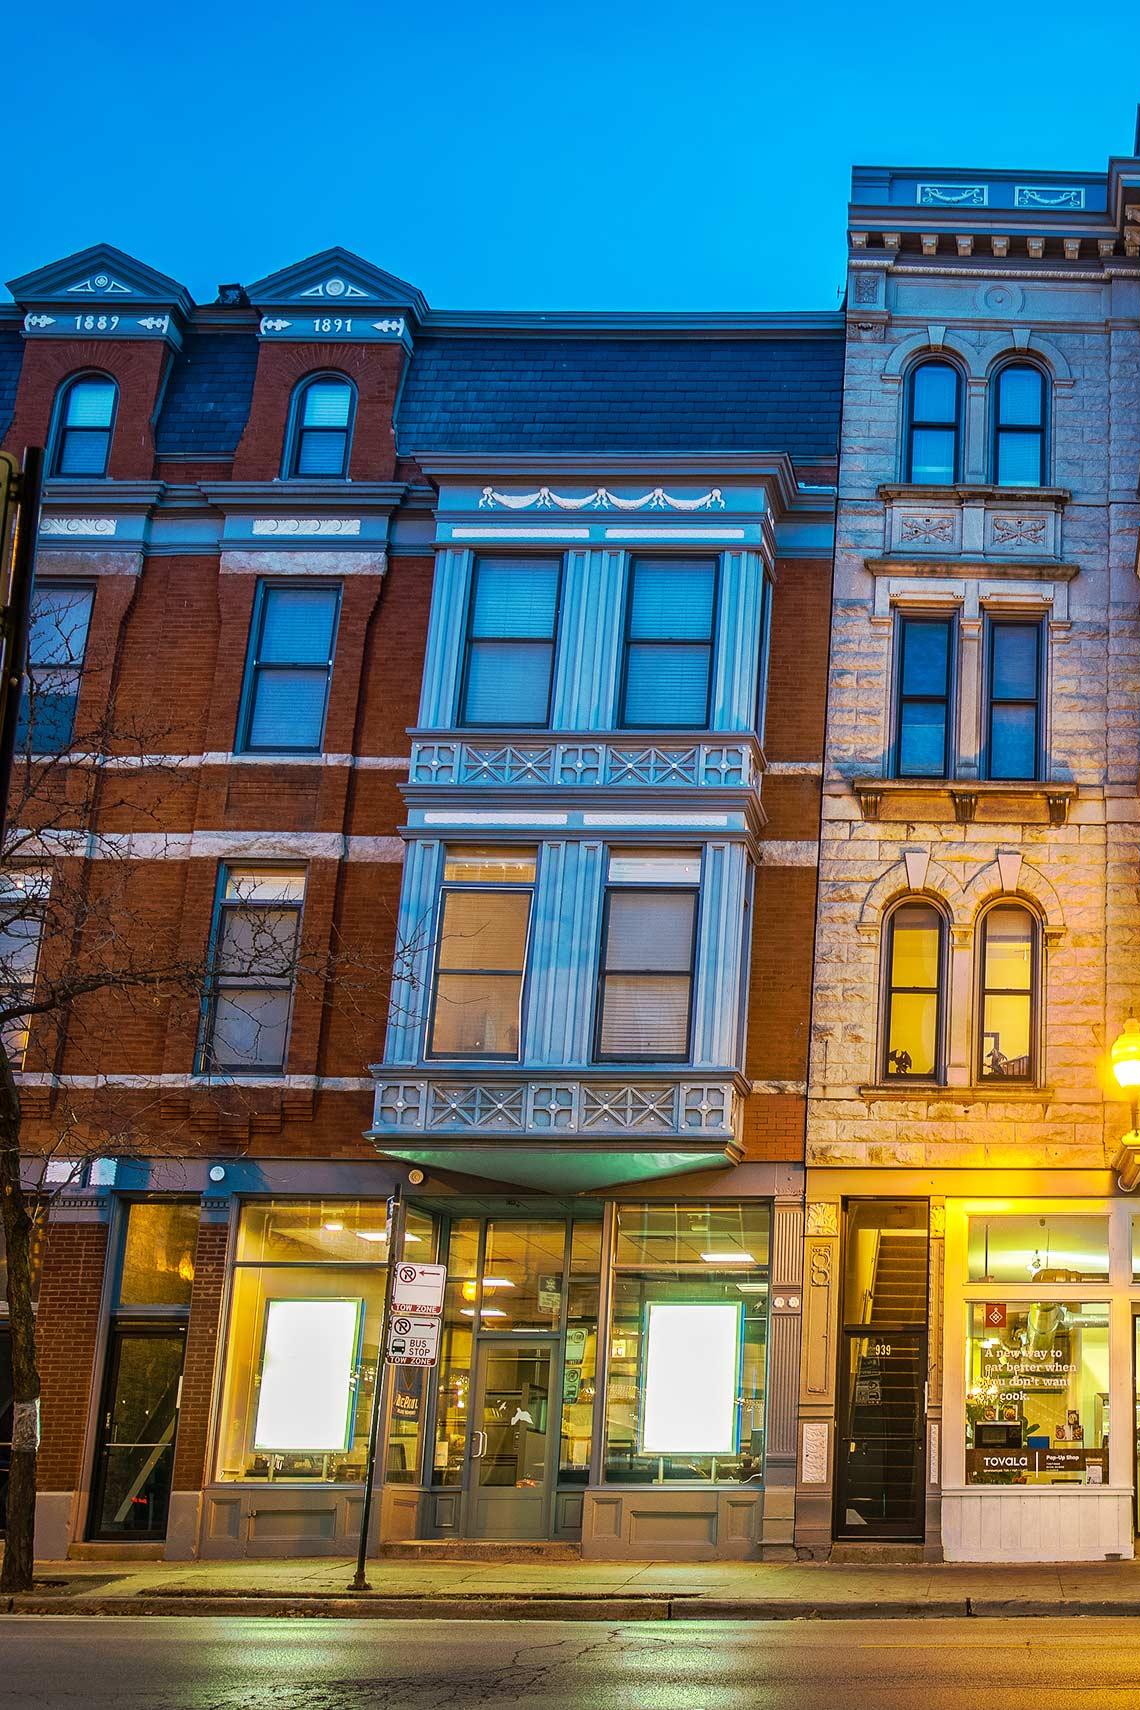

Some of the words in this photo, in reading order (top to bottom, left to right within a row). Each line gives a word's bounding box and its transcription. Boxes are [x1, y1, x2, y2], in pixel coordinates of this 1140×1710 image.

[74, 315, 120, 330] 1889
[313, 318, 352, 332] 1891
[395, 1304, 413, 1312] TOW
[416, 1305, 438, 1313] ZONE
[410, 1340, 427, 1348] BUS
[408, 1348, 431, 1357] STOP
[875, 1344, 891, 1356] 939
[984, 1348, 993, 1358] A
[996, 1349, 1020, 1358] new
[1050, 1348, 1063, 1358] to
[410, 1357, 432, 1365] ZONE
[984, 1363, 1003, 1372] eat
[1006, 1361, 1041, 1372] better
[1044, 1361, 1077, 1372] when
[999, 1390, 1030, 1401] cook.
[1046, 1454, 1066, 1462] Pop-Up
